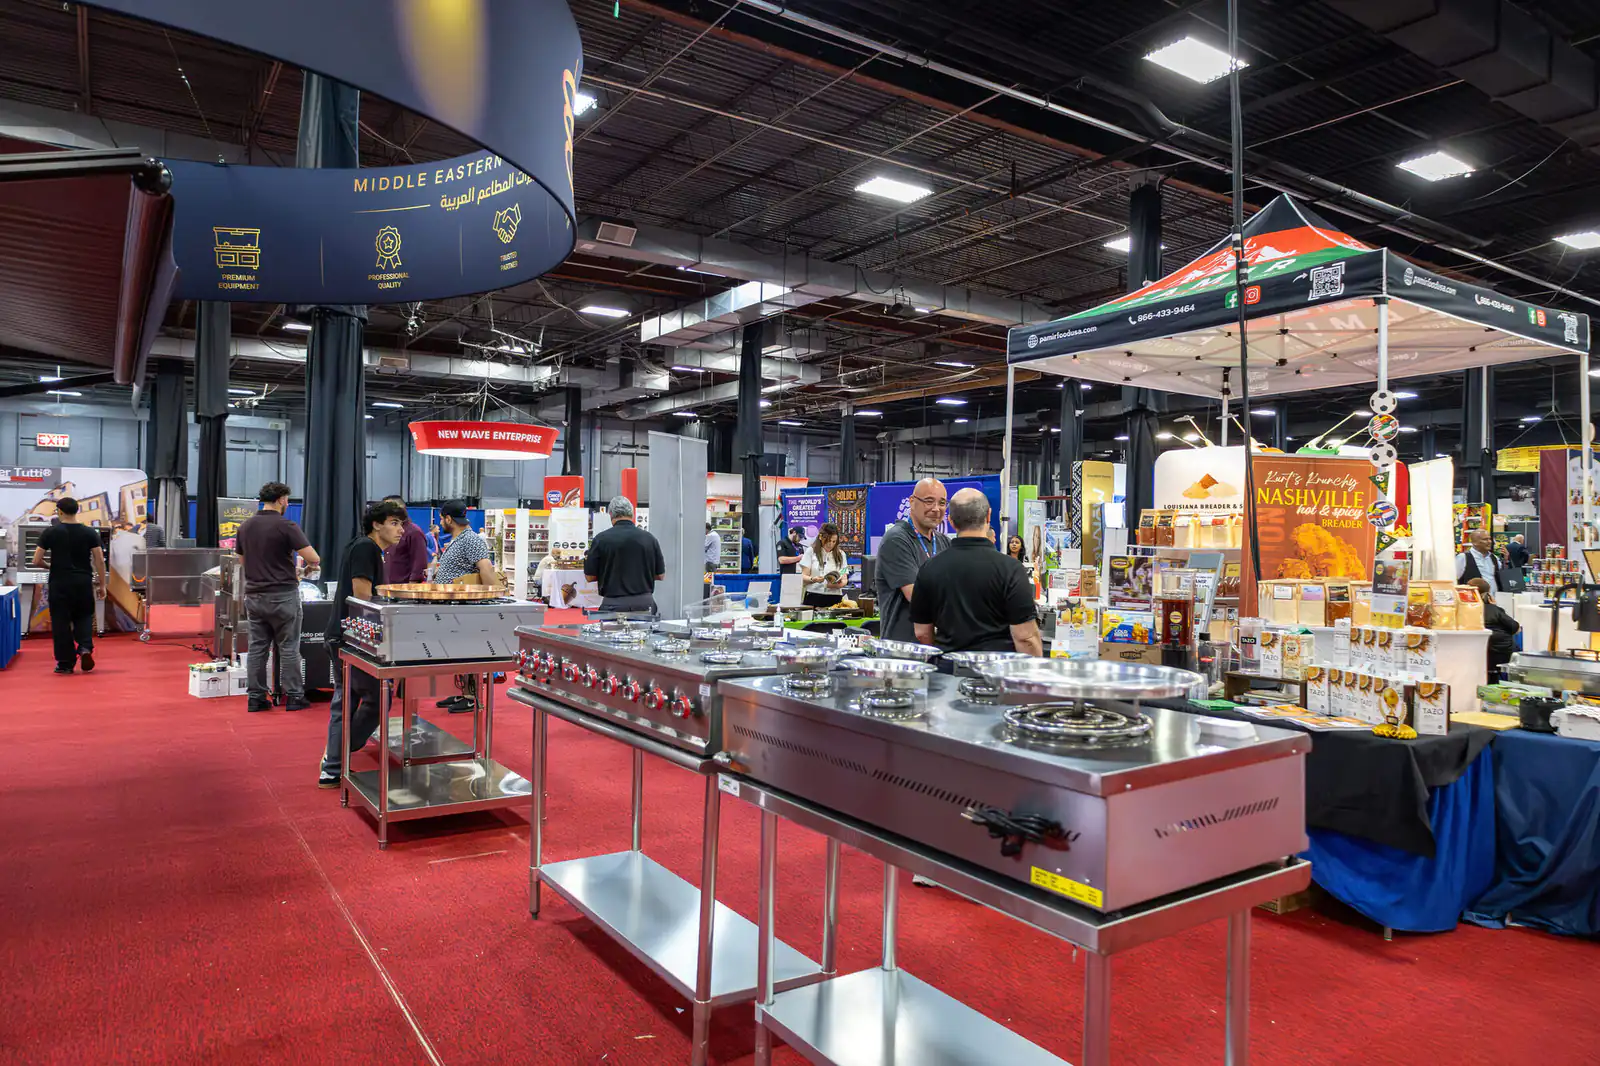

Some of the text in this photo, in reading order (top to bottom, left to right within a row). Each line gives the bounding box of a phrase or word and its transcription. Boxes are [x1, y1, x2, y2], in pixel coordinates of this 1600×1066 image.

[354, 155, 503, 193] MIDDLE EASTERN
[477, 172, 515, 205] المطاعم
[440, 186, 475, 212] العربية
[222, 273, 256, 281] PREMIUM
[368, 272, 409, 281] PROFESSIONAL
[218, 282, 260, 290] EQUIPMENT
[377, 281, 402, 290] QUALITY
[1413, 275, 1457, 296] pamirfoodusa.com
[1137, 303, 1196, 322] 866-433-9464
[1039, 325, 1097, 344] pamirfoodusa.com
[38, 434, 69, 446] EXIT
[438, 430, 542, 444] NEW WAVE ENTERPRISE
[1265, 470, 1359, 492] Kurt's Krunchy
[1257, 487, 1365, 509] NASHVILLE
[1296, 503, 1364, 520] hot & spicy
[1322, 518, 1363, 529] BREADER
[1309, 688, 1326, 697] TAZO
[1423, 707, 1444, 715] TAZO
